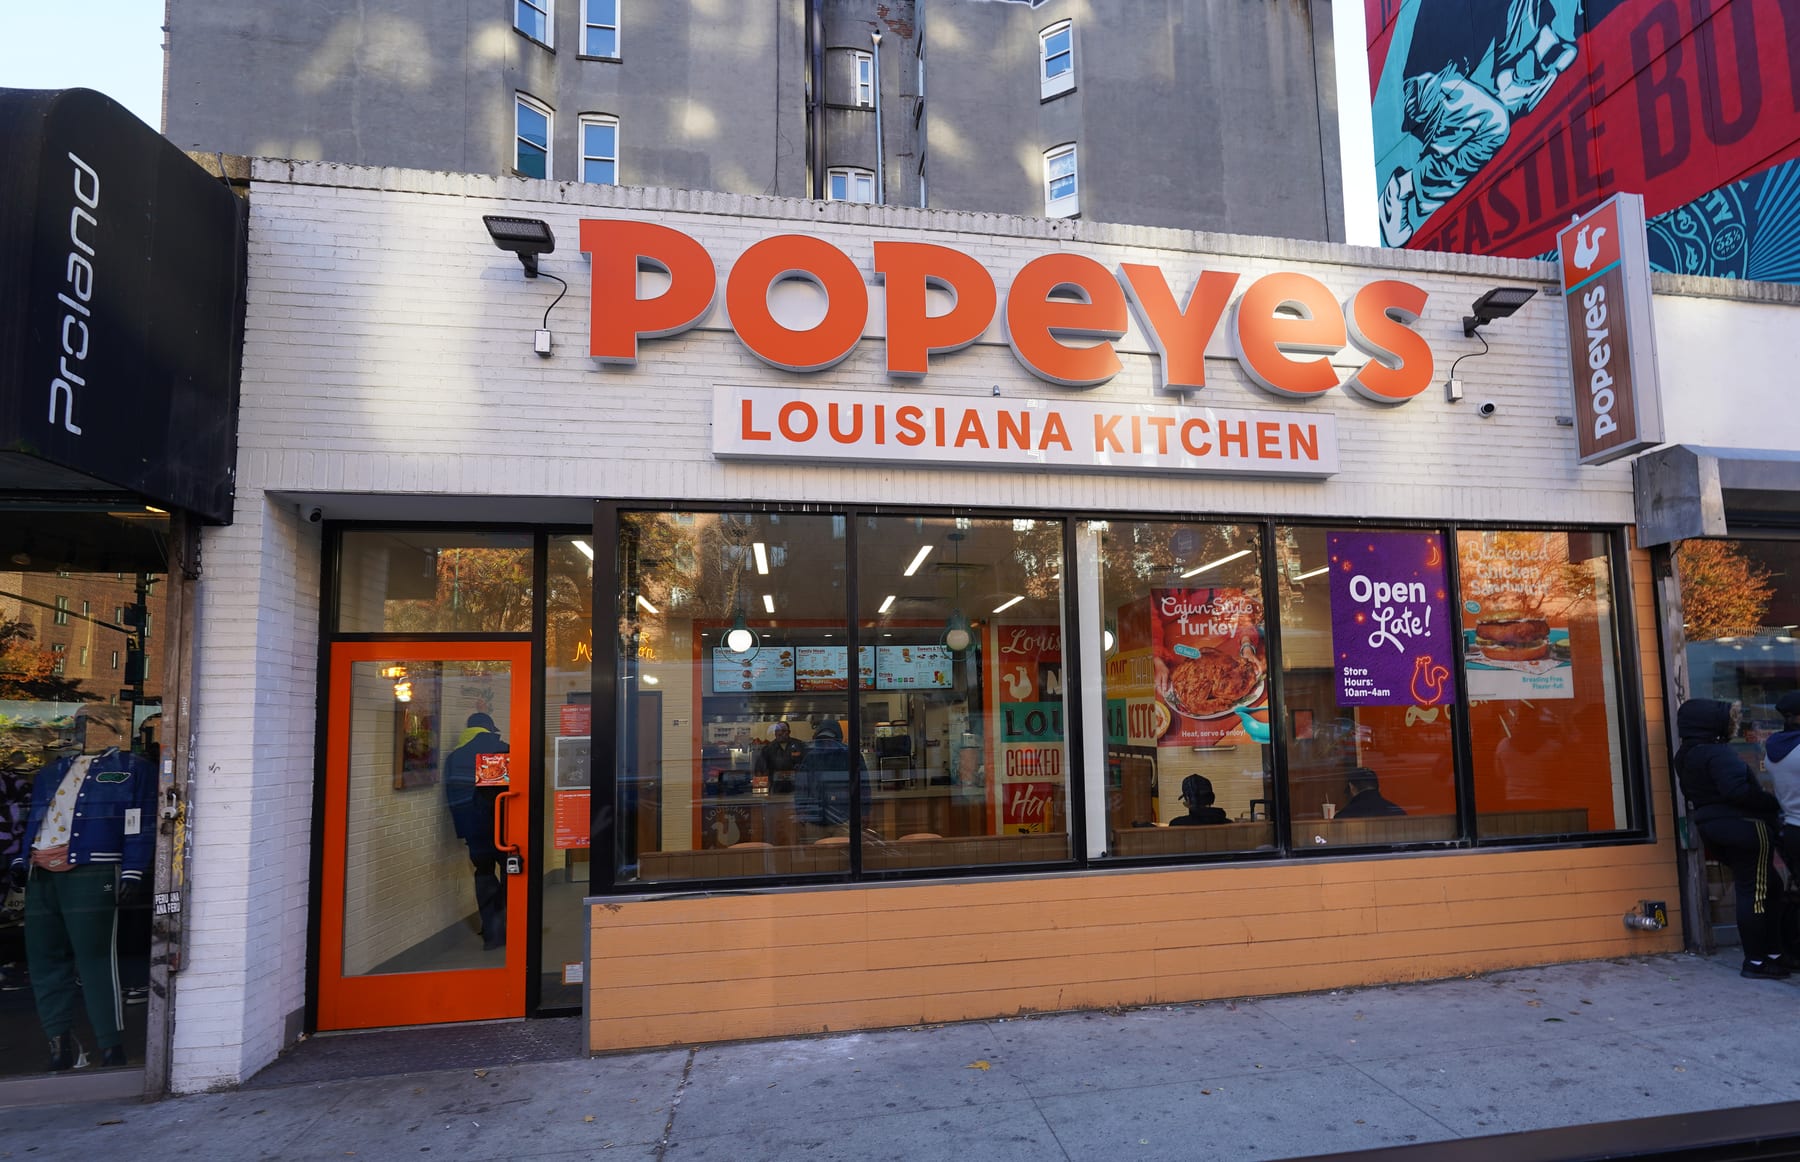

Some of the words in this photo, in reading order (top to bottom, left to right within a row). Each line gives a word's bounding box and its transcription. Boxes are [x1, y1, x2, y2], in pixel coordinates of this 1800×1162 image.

[49, 151, 100, 435] Proland
[740, 397, 1073, 453] LOUISIANA
[1093, 414, 1319, 461] KITCHEN
[1476, 562, 1540, 579] Chicken
[1349, 574, 1426, 609] Open
[1160, 596, 1254, 619] Cajun-Style
[1178, 618, 1239, 639] Turkey
[1368, 604, 1432, 654] Late!
[1343, 666, 1368, 676] Store
[1344, 677, 1374, 687] Hours:
[1344, 687, 1391, 697] 10am-4am
[1006, 748, 1060, 777] COOKED
